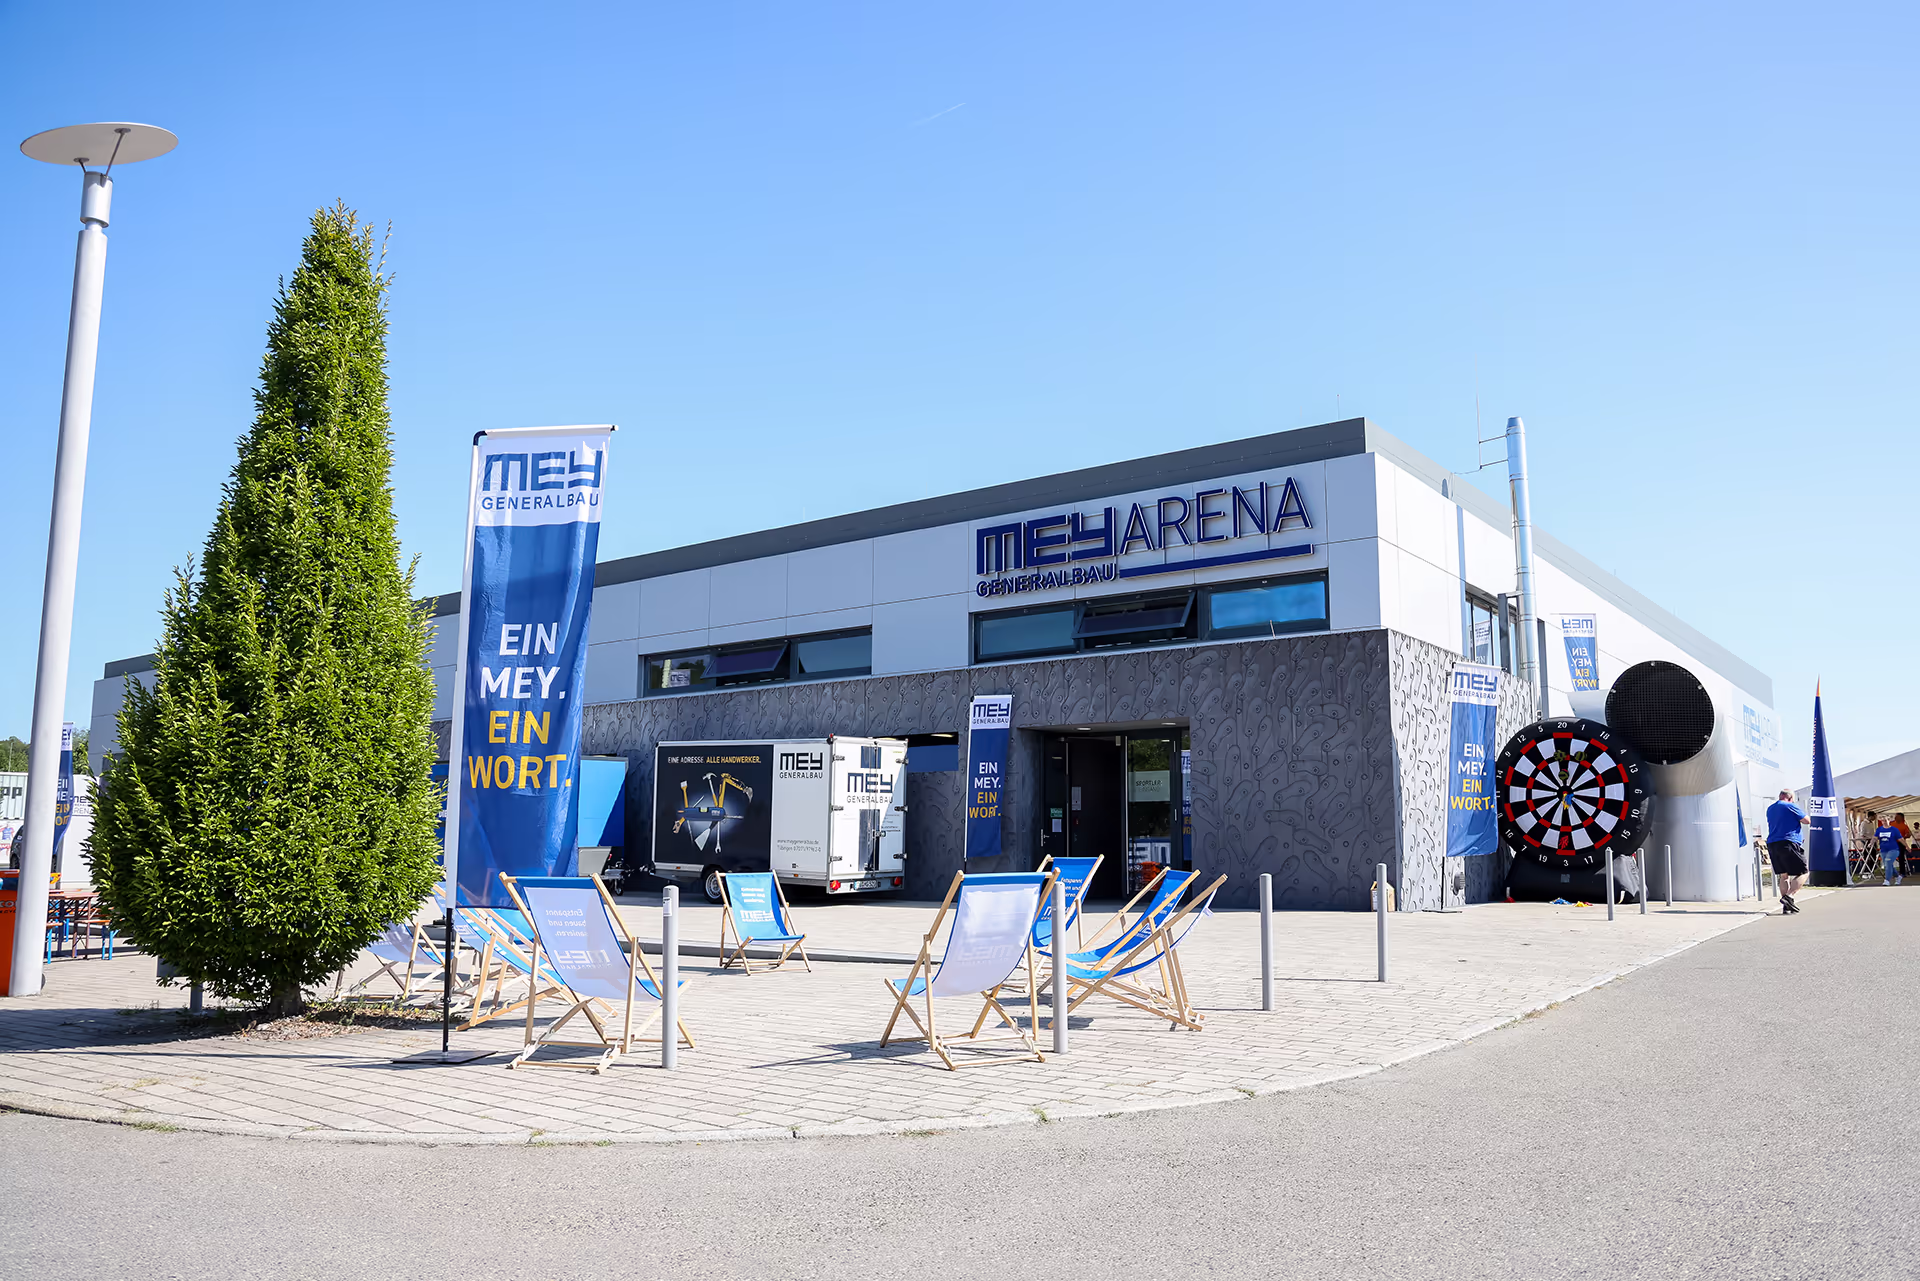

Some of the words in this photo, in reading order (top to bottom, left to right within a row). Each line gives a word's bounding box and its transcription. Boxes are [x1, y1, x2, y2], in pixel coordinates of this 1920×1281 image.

[483, 450, 602, 492] MEY
[481, 493, 600, 511] GENERALBAU
[976, 505, 1117, 577] MEY
[1119, 476, 1313, 556] ARENA
[976, 562, 1117, 598] GENERALBAU
[499, 622, 558, 656] EIN
[480, 665, 566, 700] MEY.
[1454, 671, 1498, 693] MEY
[1453, 689, 1497, 700] GENERALBAU
[972, 702, 1010, 718] MEY
[488, 709, 551, 745] EIN
[972, 717, 1009, 725] GENERALBAU
[1557, 721, 1568, 729] 20
[1537, 725, 1544, 733] 5
[1516, 734, 1527, 744] 12
[1600, 730, 1611, 741] 18
[1463, 743, 1485, 758] EIN
[668, 756, 680, 764] EINE
[706, 755, 720, 763] ALLE
[720, 755, 761, 763] HANDWERKER.
[780, 752, 823, 770] MEY
[468, 753, 573, 789] WORT.
[978, 762, 998, 774] EIN
[1457, 760, 1487, 776] MEY.
[1628, 763, 1639, 774] 13
[779, 771, 823, 779] GENERALBAU
[847, 772, 893, 793] MEY
[974, 777, 1001, 789] MEY.
[1462, 778, 1483, 793] EIN
[846, 795, 893, 804] GENERALBAU
[977, 791, 998, 804] EIN
[1450, 795, 1495, 811] WORT.
[968, 804, 1001, 819] WORT.
[1630, 808, 1641, 819] 10
[1621, 829, 1631, 840] 15
[1520, 844, 1528, 852] 7
[1538, 854, 1548, 863] 19
[1563, 859, 1569, 867] 3
[1584, 855, 1594, 864] 17
